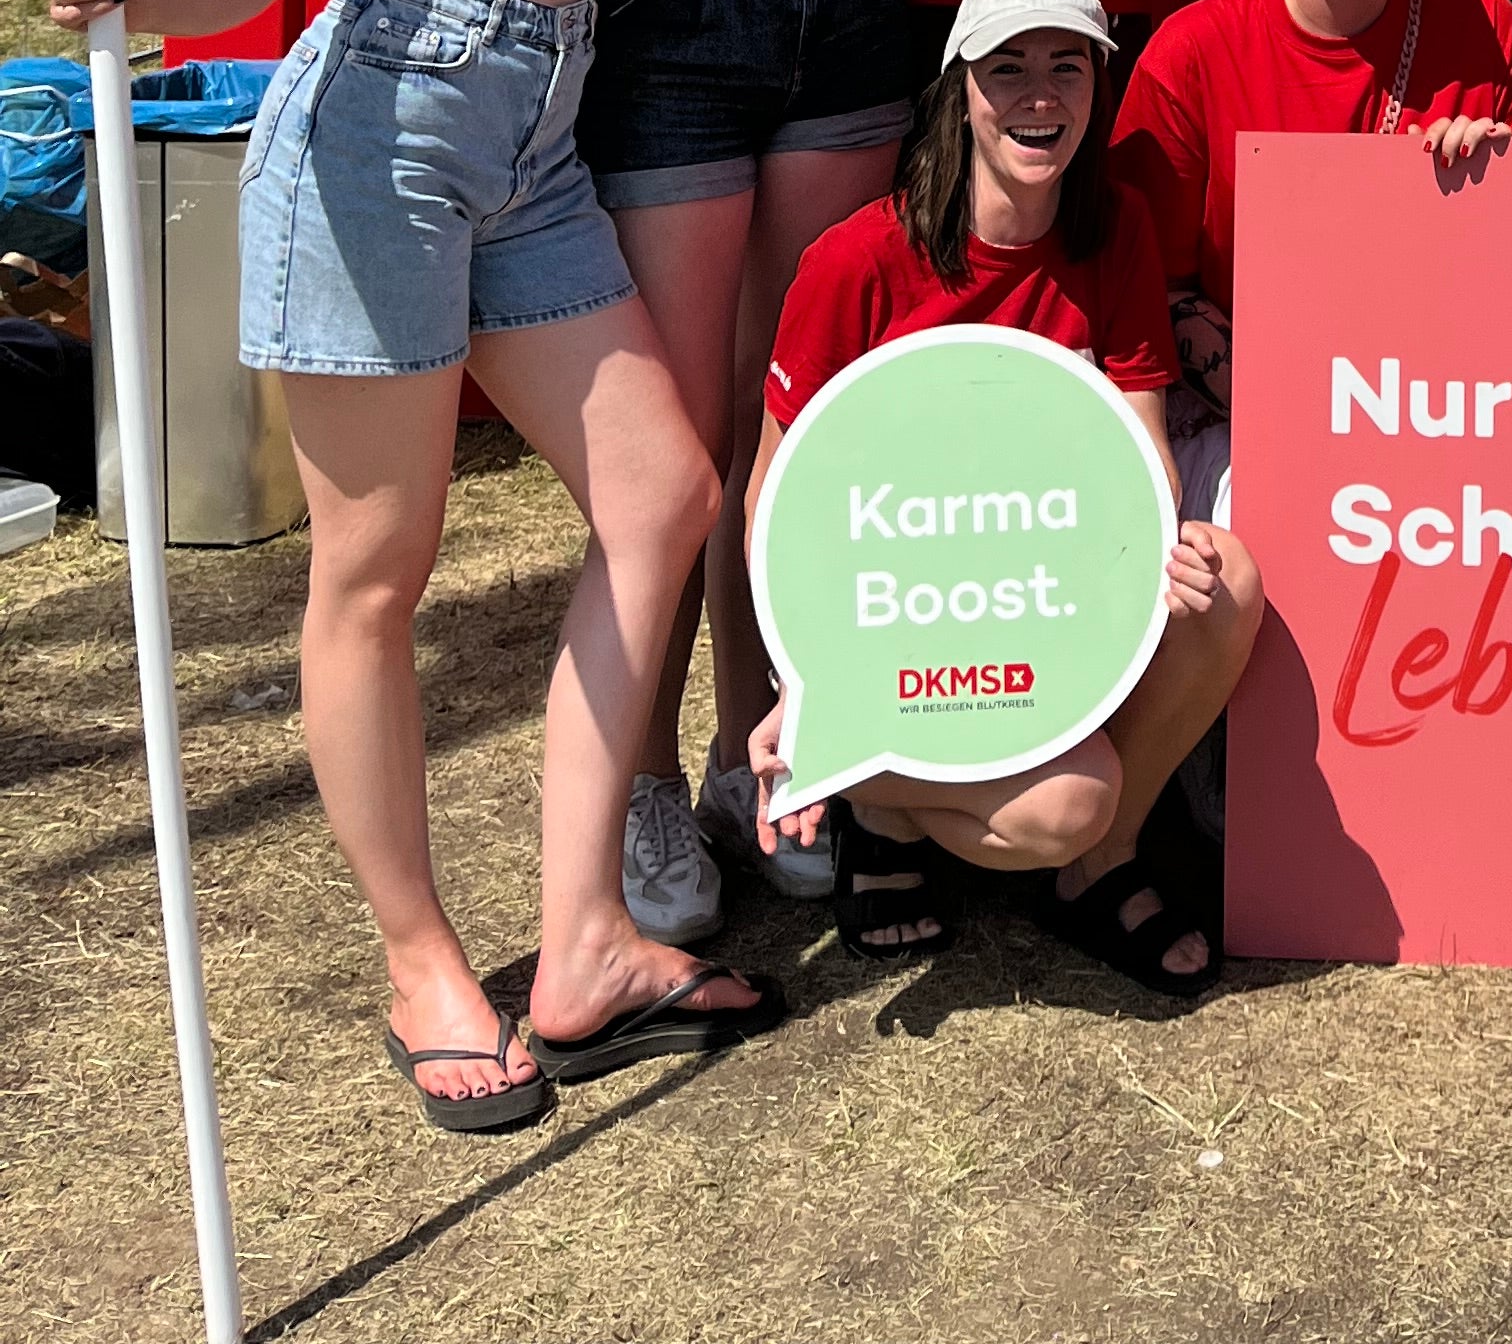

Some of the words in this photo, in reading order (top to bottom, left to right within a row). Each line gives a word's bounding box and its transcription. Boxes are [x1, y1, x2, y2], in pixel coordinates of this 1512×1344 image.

[1330, 357, 1512, 438] Nur
[849, 483, 1078, 541] Karma
[854, 565, 1076, 628] Boost.
[899, 665, 1001, 699] DKMS
[899, 704, 920, 715] WIR
[922, 701, 973, 714] BESIEGEN
[976, 698, 1035, 711] BLUTKREBS
